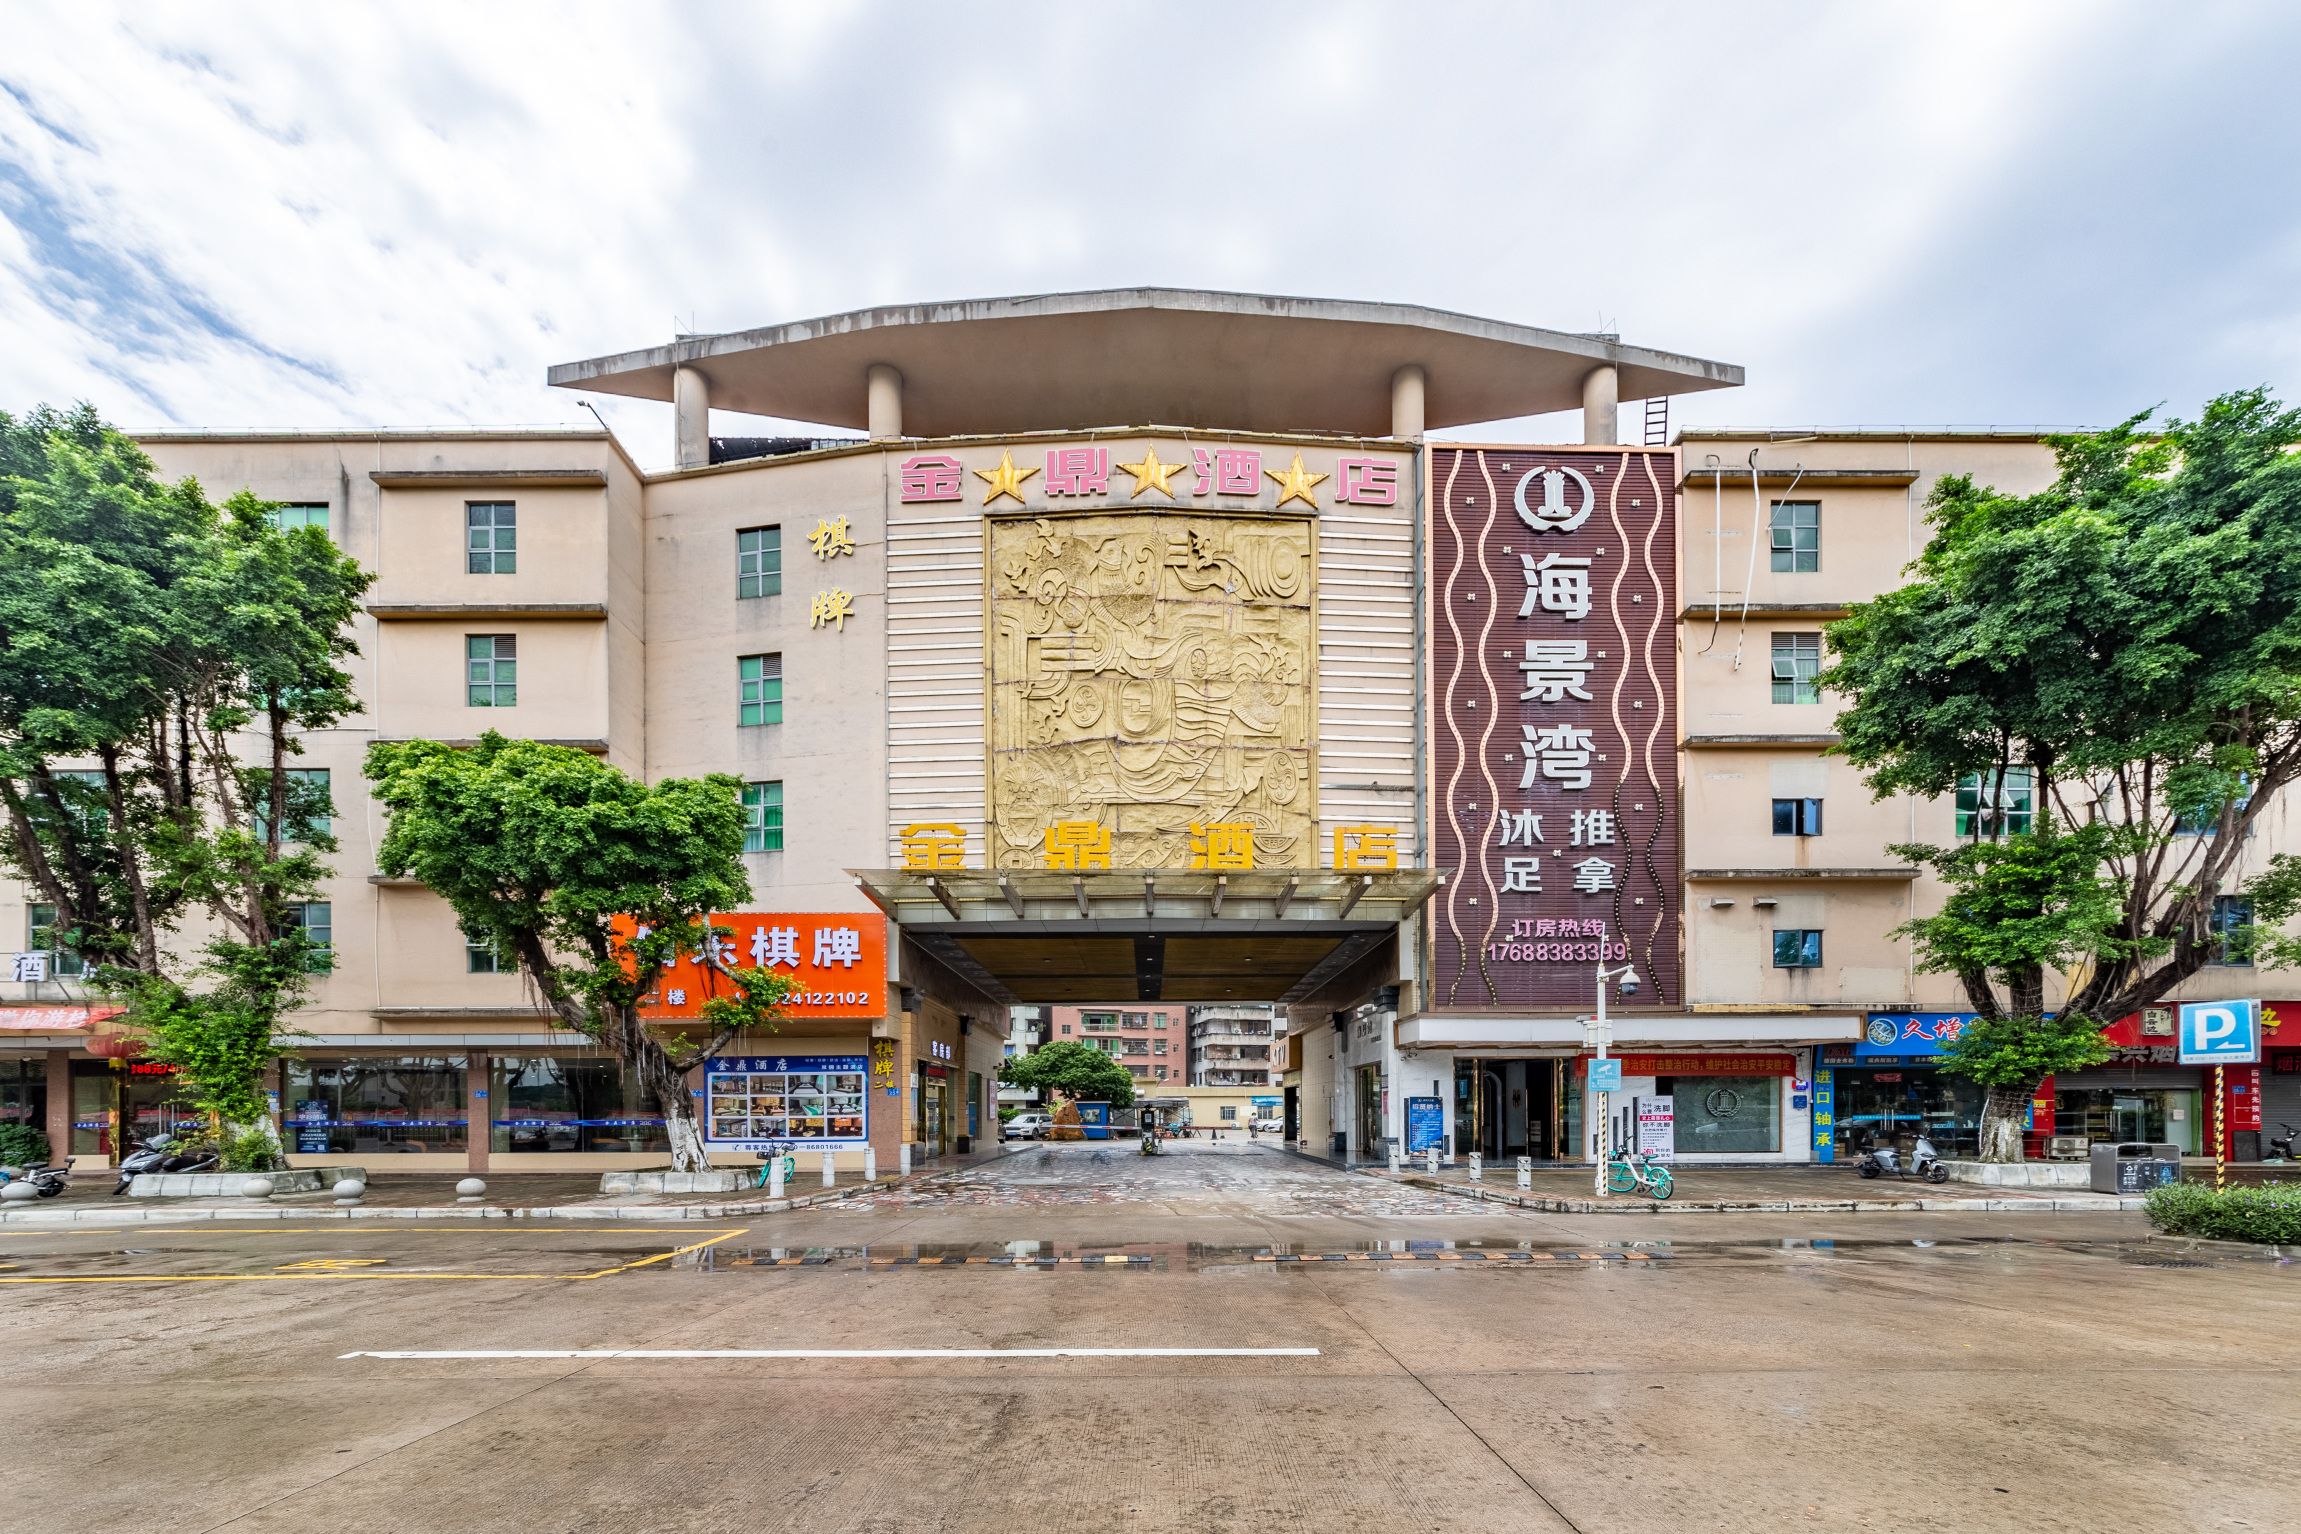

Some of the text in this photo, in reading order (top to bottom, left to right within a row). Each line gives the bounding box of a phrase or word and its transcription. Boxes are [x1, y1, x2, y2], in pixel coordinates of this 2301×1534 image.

[900, 447, 1398, 505] 金鼎酒店
[807, 514, 855, 632] 棋牌
[1517, 552, 1595, 790] 海景湾
[900, 821, 1398, 870] 金鼎酒店
[1512, 919, 1604, 938] 订房热线
[1487, 943, 1626, 961] 17688383399
[1902, 1018, 1980, 1041] 久增
[2195, 1008, 2236, 1050] P
[716, 1059, 787, 1071] 金鼎酒店
[874, 1040, 895, 1078] 棋牌
[1272, 1044, 1286, 1067] KTV
[1815, 1070, 1831, 1147] 进口轴承
